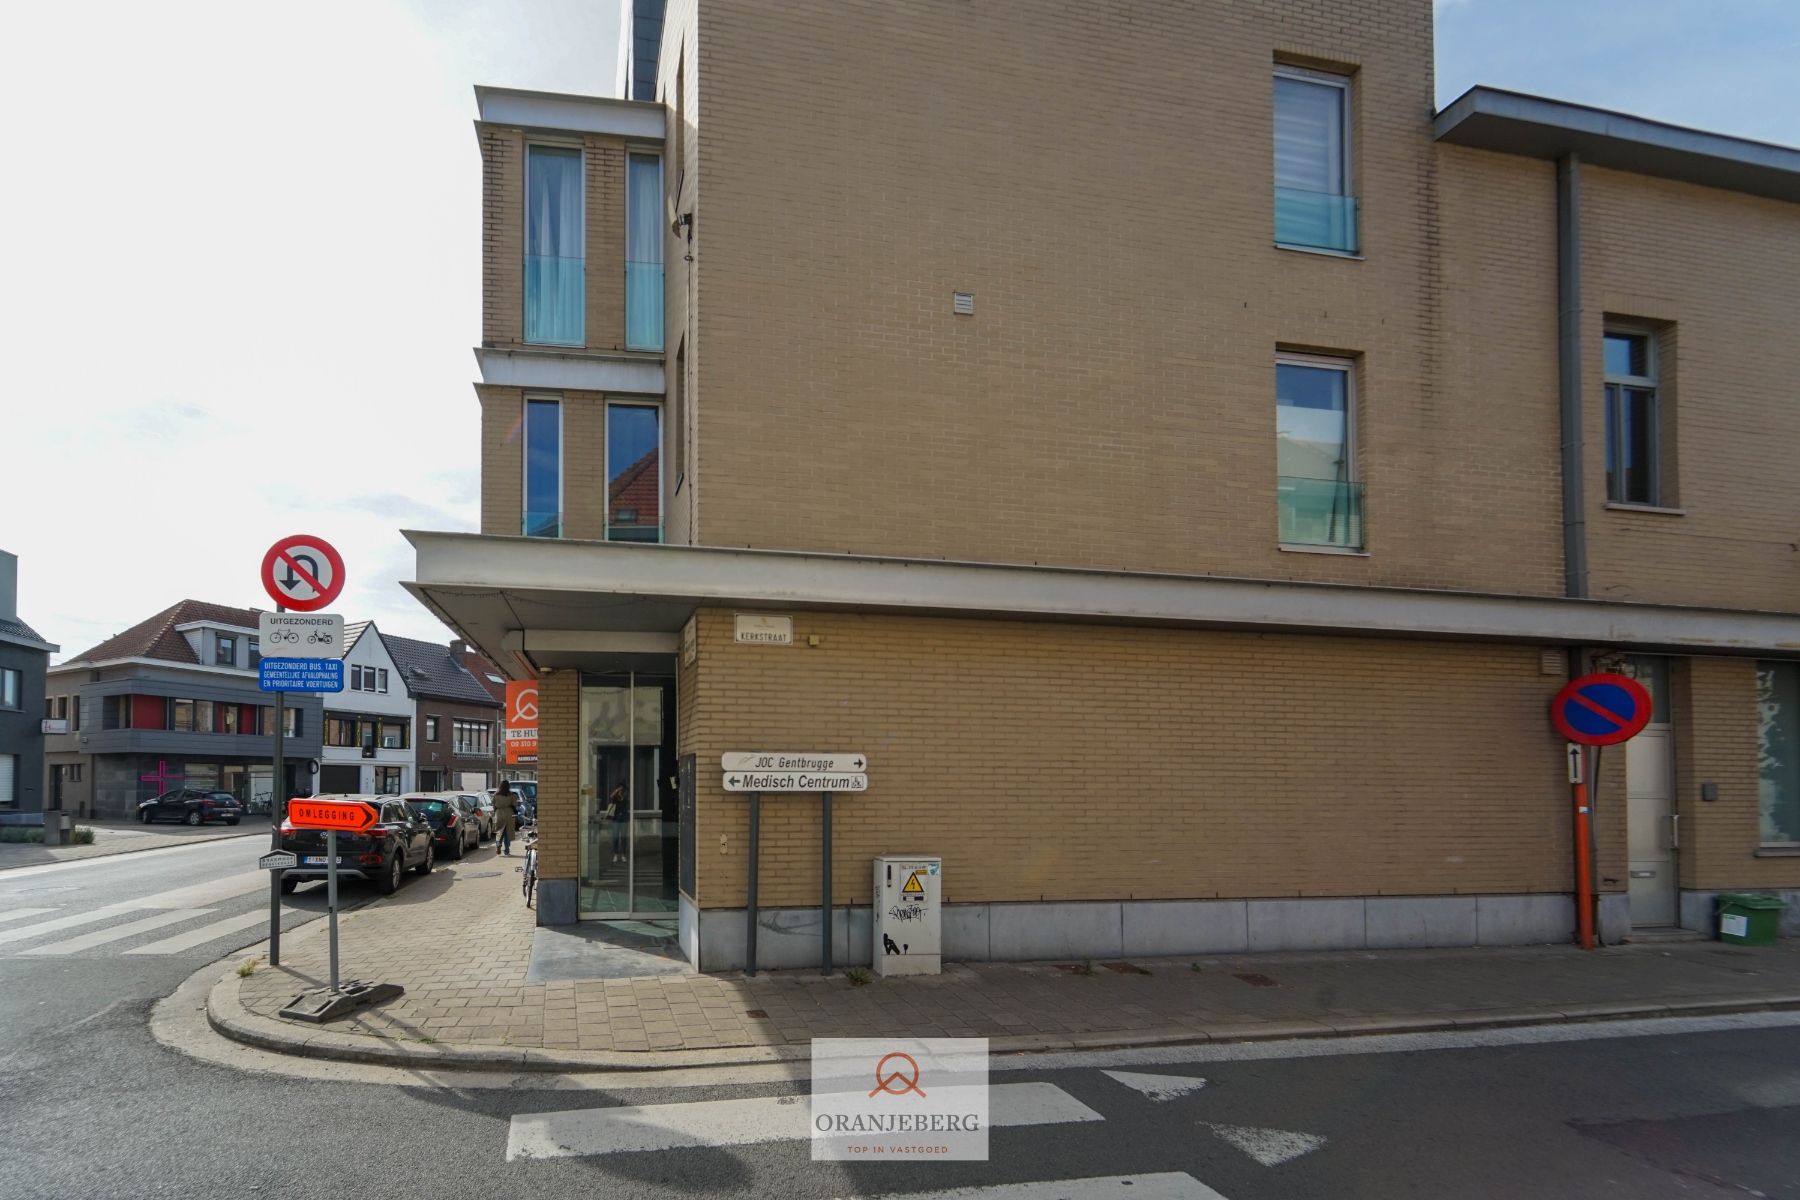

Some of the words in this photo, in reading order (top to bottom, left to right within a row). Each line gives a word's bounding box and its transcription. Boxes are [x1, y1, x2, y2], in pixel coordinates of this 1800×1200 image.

[270, 617, 334, 626] UITGEZONDERD
[741, 632, 787, 642] KERKSTRAAT
[264, 662, 308, 670] UITGEZONDERD
[325, 663, 338, 671] TAXI
[263, 671, 301, 679] GEMEENTELIJKE
[272, 680, 305, 688] PRIORITAIRE
[755, 757, 774, 768] JOC
[778, 757, 834, 771] Gentbrugge
[742, 774, 794, 788] Medisch
[798, 774, 850, 788] Centrum
[299, 808, 355, 821] OMLEGGING
